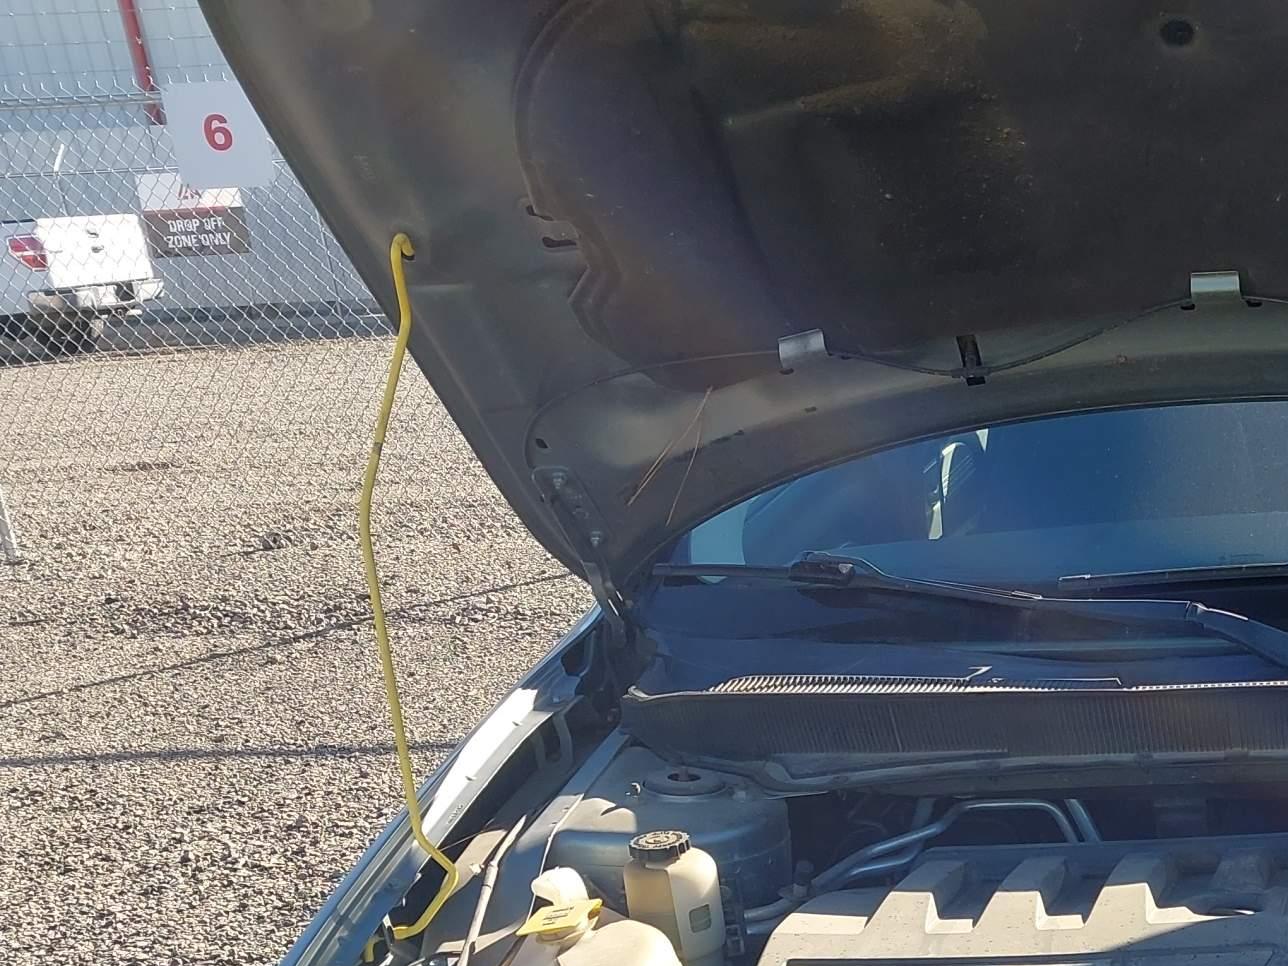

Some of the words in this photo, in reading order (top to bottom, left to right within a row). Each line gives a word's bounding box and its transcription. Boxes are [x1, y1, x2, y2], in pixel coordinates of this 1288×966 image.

[203, 113, 234, 152] 6
[167, 217, 201, 233] DROP
[203, 216, 224, 230] OFF
[167, 234, 199, 248] ZONE
[200, 232, 231, 246] ONLY
